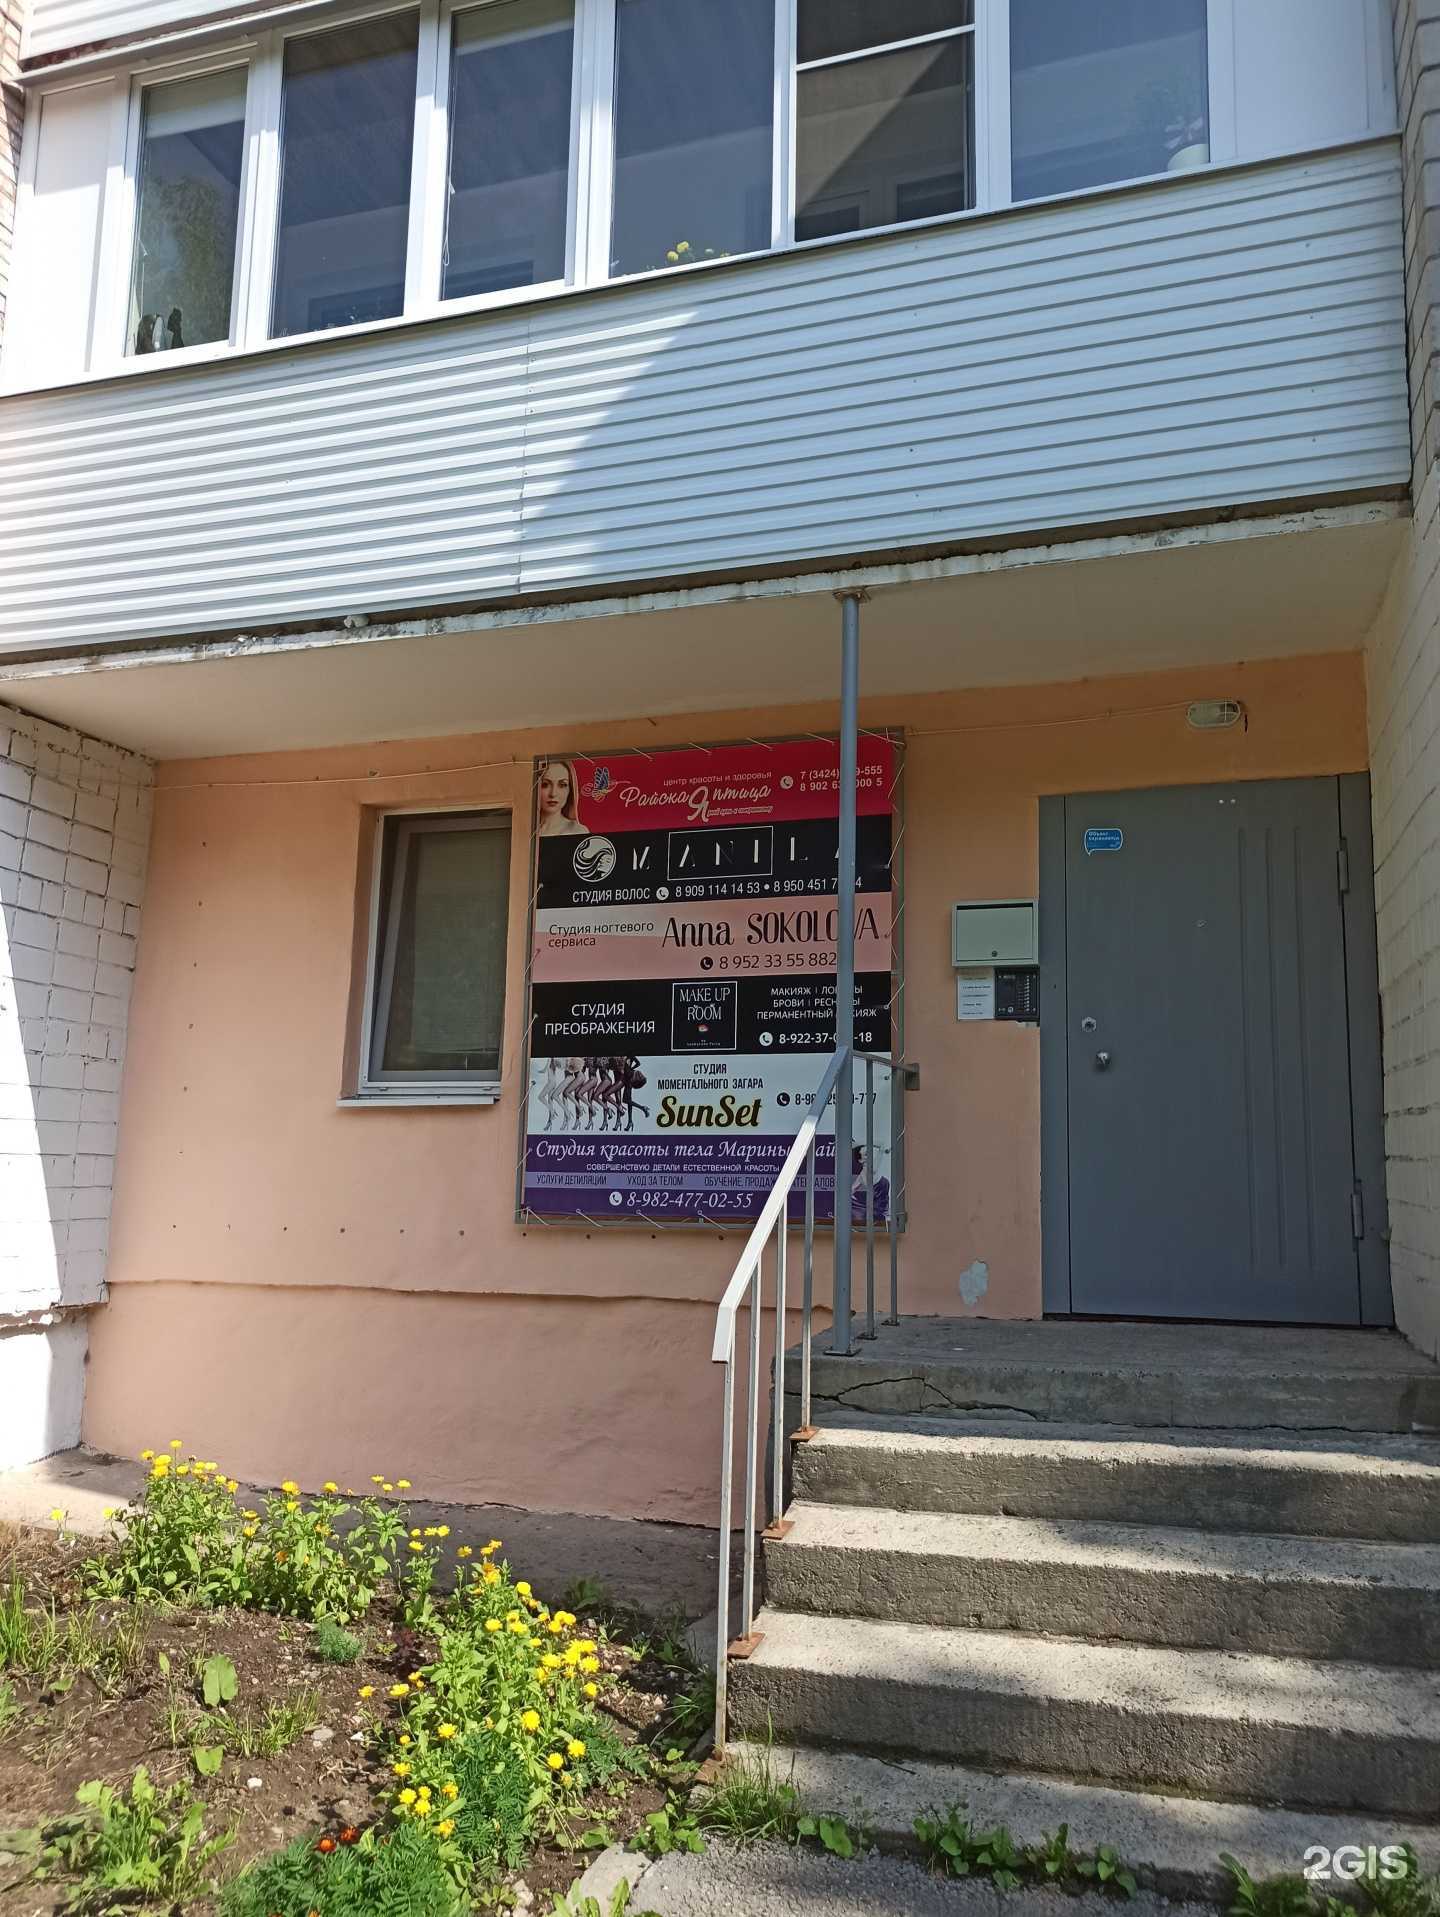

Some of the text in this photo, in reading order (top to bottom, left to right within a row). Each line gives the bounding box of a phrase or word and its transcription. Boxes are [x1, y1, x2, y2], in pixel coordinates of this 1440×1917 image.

[734, 771, 772, 782] здоровья
[800, 771, 807, 780] 7
[809, 769, 840, 780] (3424)
[800, 782, 806, 791] 8
[810, 781, 828, 791] 902
[876, 778, 883, 786] 5
[712, 785, 772, 802] птица
[572, 889, 612, 903] СТУДИЯ
[615, 887, 650, 900] ВОЛОС
[675, 886, 682, 897] 8
[685, 885, 705, 896] 909
[708, 883, 727, 895] 114
[731, 883, 743, 894] 14
[746, 882, 760, 893] 53
[773, 880, 780, 892] 8
[783, 879, 804, 891] 950
[807, 879, 826, 890] 451
[549, 921, 654, 937] Студия ногтевого
[662, 917, 735, 948] Anna
[548, 936, 596, 949] сервиса
[719, 952, 837, 969] 8 952 33 55 882
[680, 987, 730, 1002] MAKE UP
[771, 987, 811, 996] МАКИЯЖ
[571, 1003, 625, 1018] СТУДИЯ
[773, 999, 804, 1008] БРОВИ
[687, 1003, 722, 1020] ROOM
[757, 1008, 834, 1020] ПЕРМАНЕНТНЫЙ
[545, 1021, 655, 1035] ПРЕОБРАЖЕНИЯ
[693, 1063, 727, 1075] СТУДИЯ
[657, 1078, 764, 1090] МОМЕНТАЛЬНОГО ЗАГАРА
[656, 1095, 763, 1128] SunSet
[536, 1139, 596, 1161] Студия
[600, 1144, 669, 1161] красоты
[674, 1144, 713, 1157] тела
[718, 1141, 791, 1162] Марины
[586, 1162, 780, 1172] СОВЕРШЕНСТВУЮ ДЕТАЛИ ЕСТЕСТВЕННОЙ КРАСОТЫ
[536, 1174, 564, 1185] УСЛУГИ
[564, 1174, 607, 1186] ДЕПИЛЯЦИИ
[627, 1176, 647, 1186] УХОД
[648, 1175, 658, 1185] ЗА
[660, 1175, 683, 1186] ТЕЛОМ
[626, 1191, 753, 1208] 8-982-477-02-55
